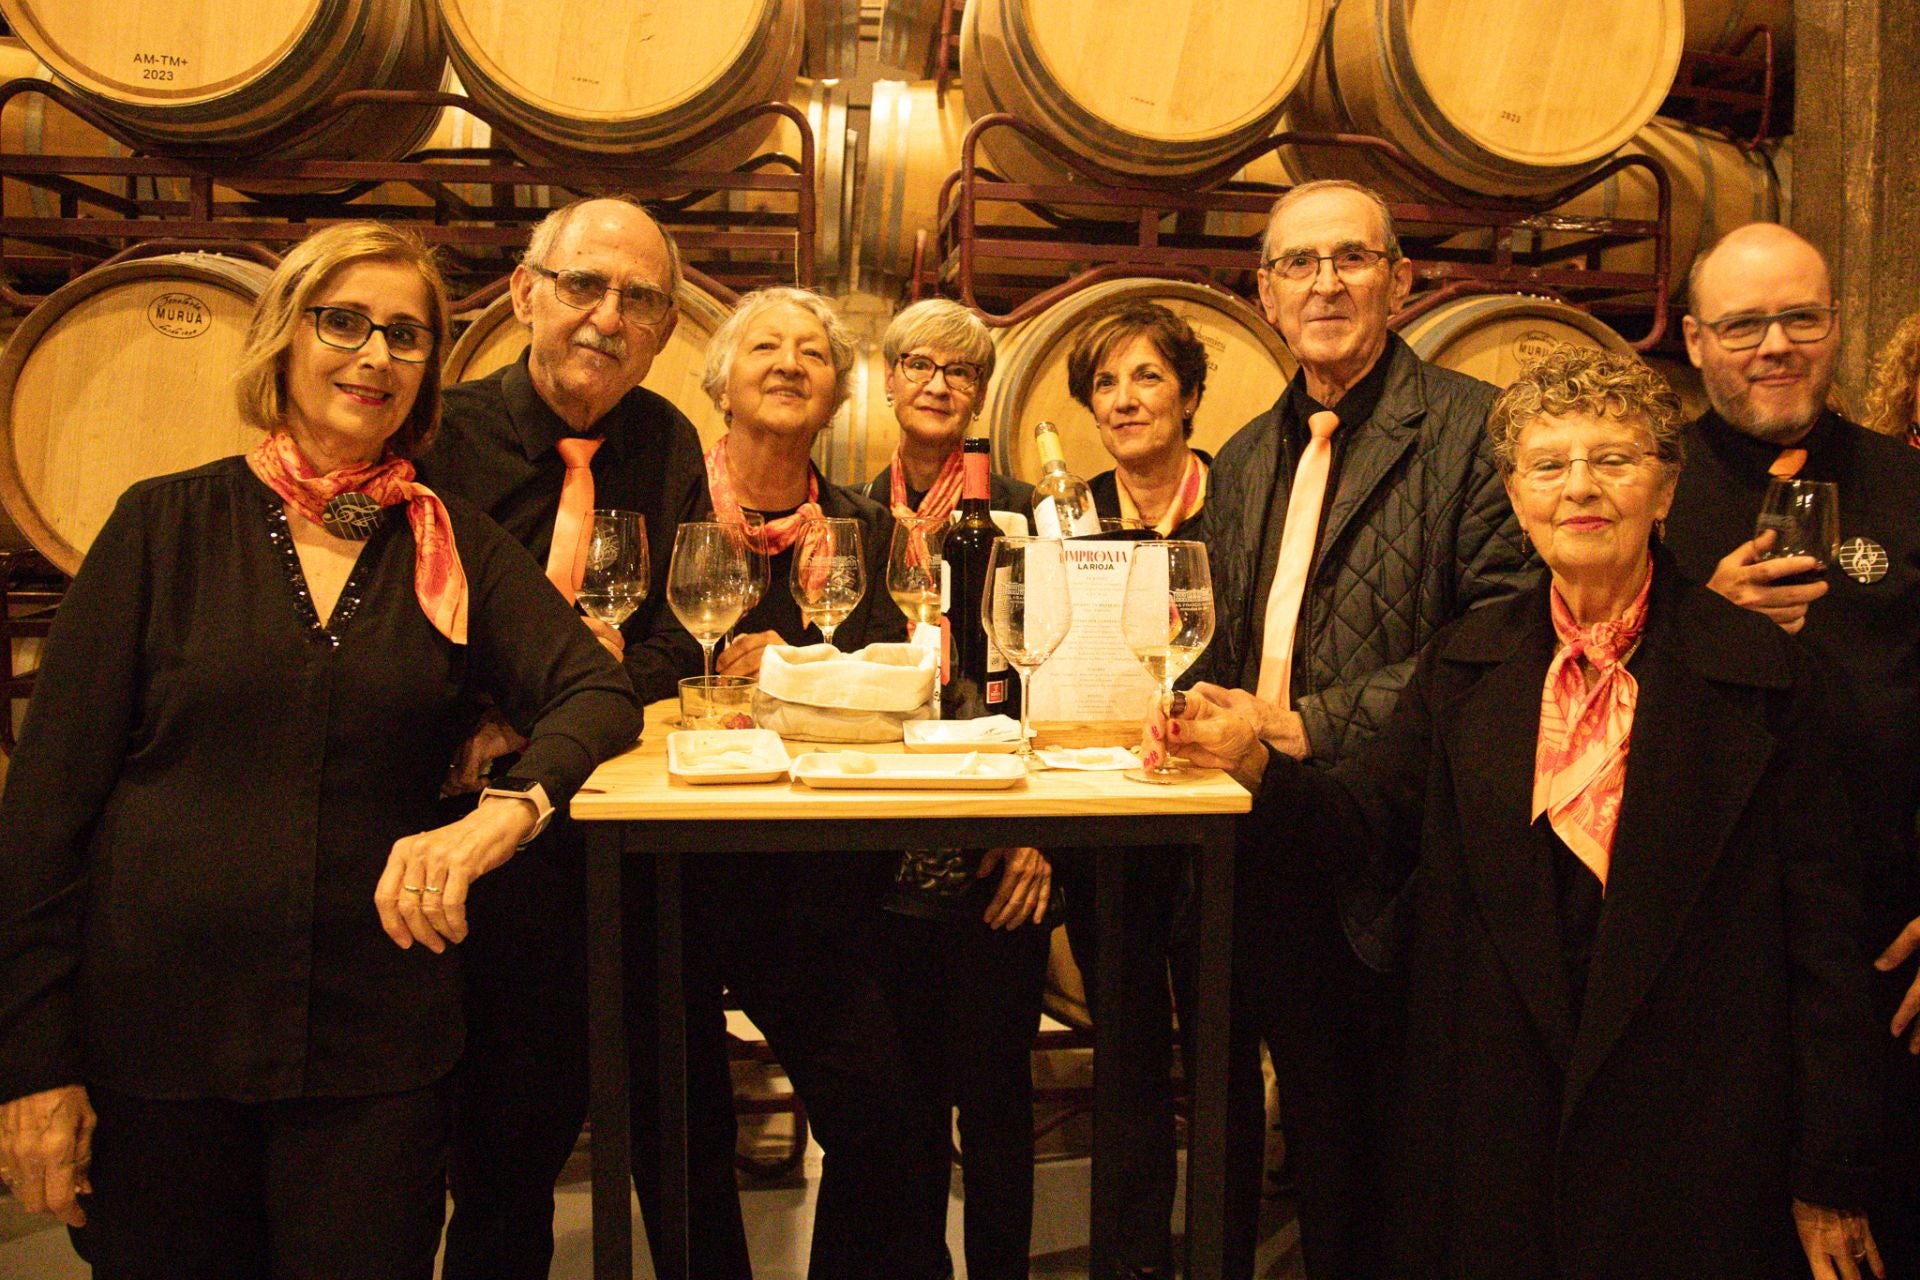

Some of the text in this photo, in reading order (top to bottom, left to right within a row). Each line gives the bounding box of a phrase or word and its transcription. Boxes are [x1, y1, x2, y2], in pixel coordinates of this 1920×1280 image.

[133, 53, 189, 67] AM-TM+
[143, 69, 174, 81] 2023
[156, 306, 202, 325] MURUA
[1519, 343, 1550, 358] MURU
[1089, 563, 1115, 572] RIOJA
